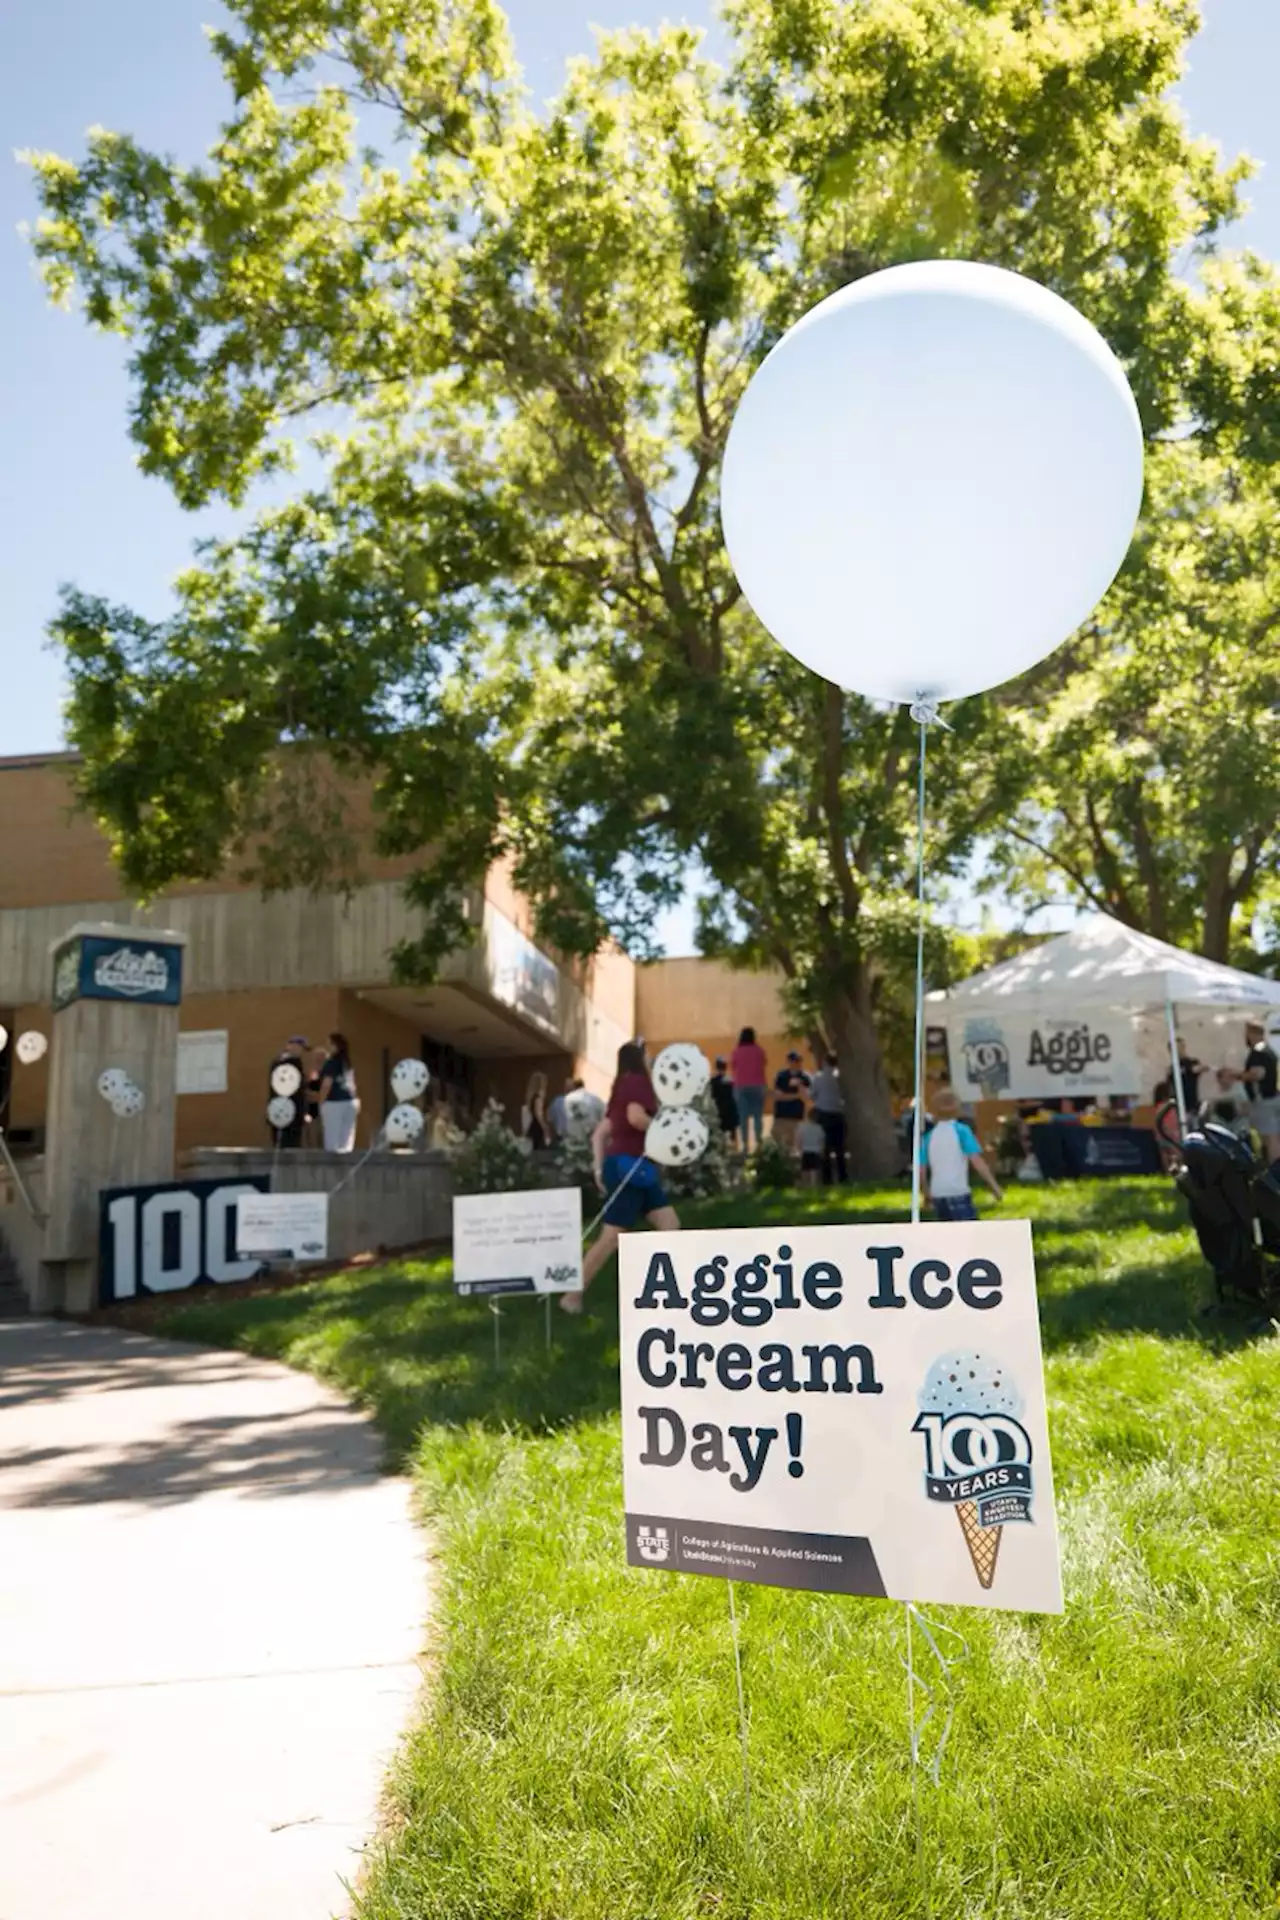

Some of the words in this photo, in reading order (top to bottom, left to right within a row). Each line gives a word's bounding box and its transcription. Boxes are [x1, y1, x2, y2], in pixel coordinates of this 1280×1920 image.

[1027, 1024, 1112, 1075] Aggie
[634, 1245, 843, 1327] Aggie
[866, 1246, 1003, 1310] Ice
[637, 1328, 883, 1394] Cream
[638, 1406, 805, 1492] Day!
[910, 1411, 1033, 1478] 100
[946, 1468, 1010, 1498] YEARS
[682, 1535, 710, 1549] College
[711, 1540, 719, 1548] of
[771, 1547, 803, 1560] Applied
